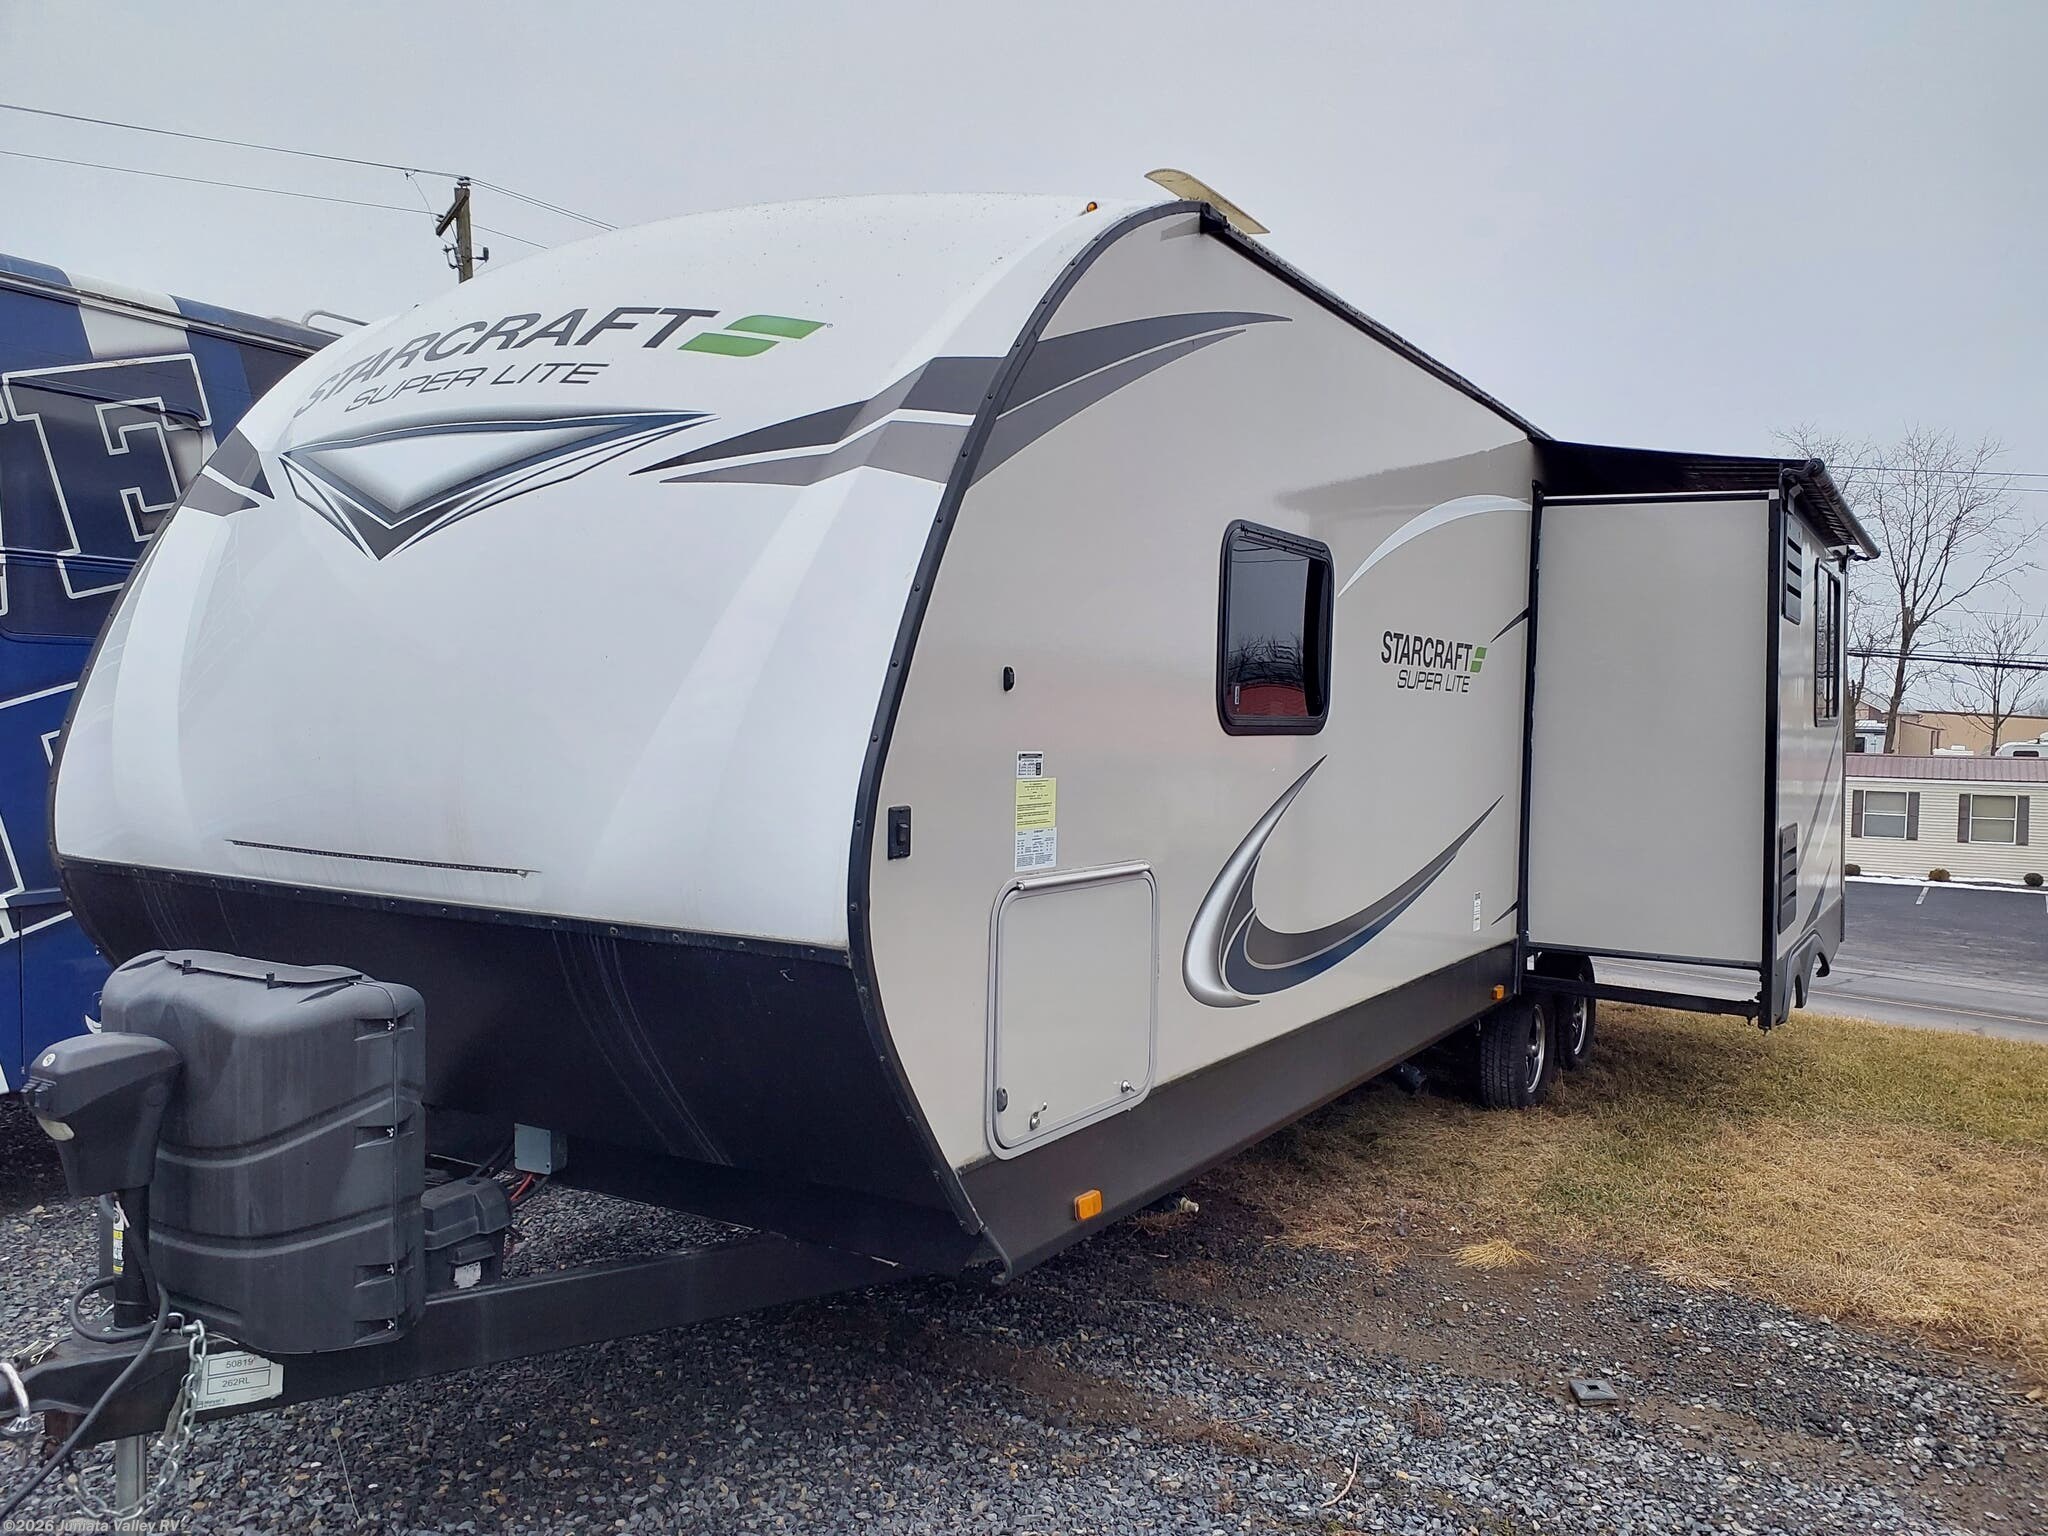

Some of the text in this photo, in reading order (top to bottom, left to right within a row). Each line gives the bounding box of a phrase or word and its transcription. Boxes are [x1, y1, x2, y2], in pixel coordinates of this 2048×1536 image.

[293, 307, 720, 419] STARCRAFT
[344, 363, 609, 412] SUPER LITE
[1381, 630, 1473, 672] STARCRAFT
[1397, 669, 1471, 693] SUPER LITE
[222, 1377, 250, 1388] 262RL
